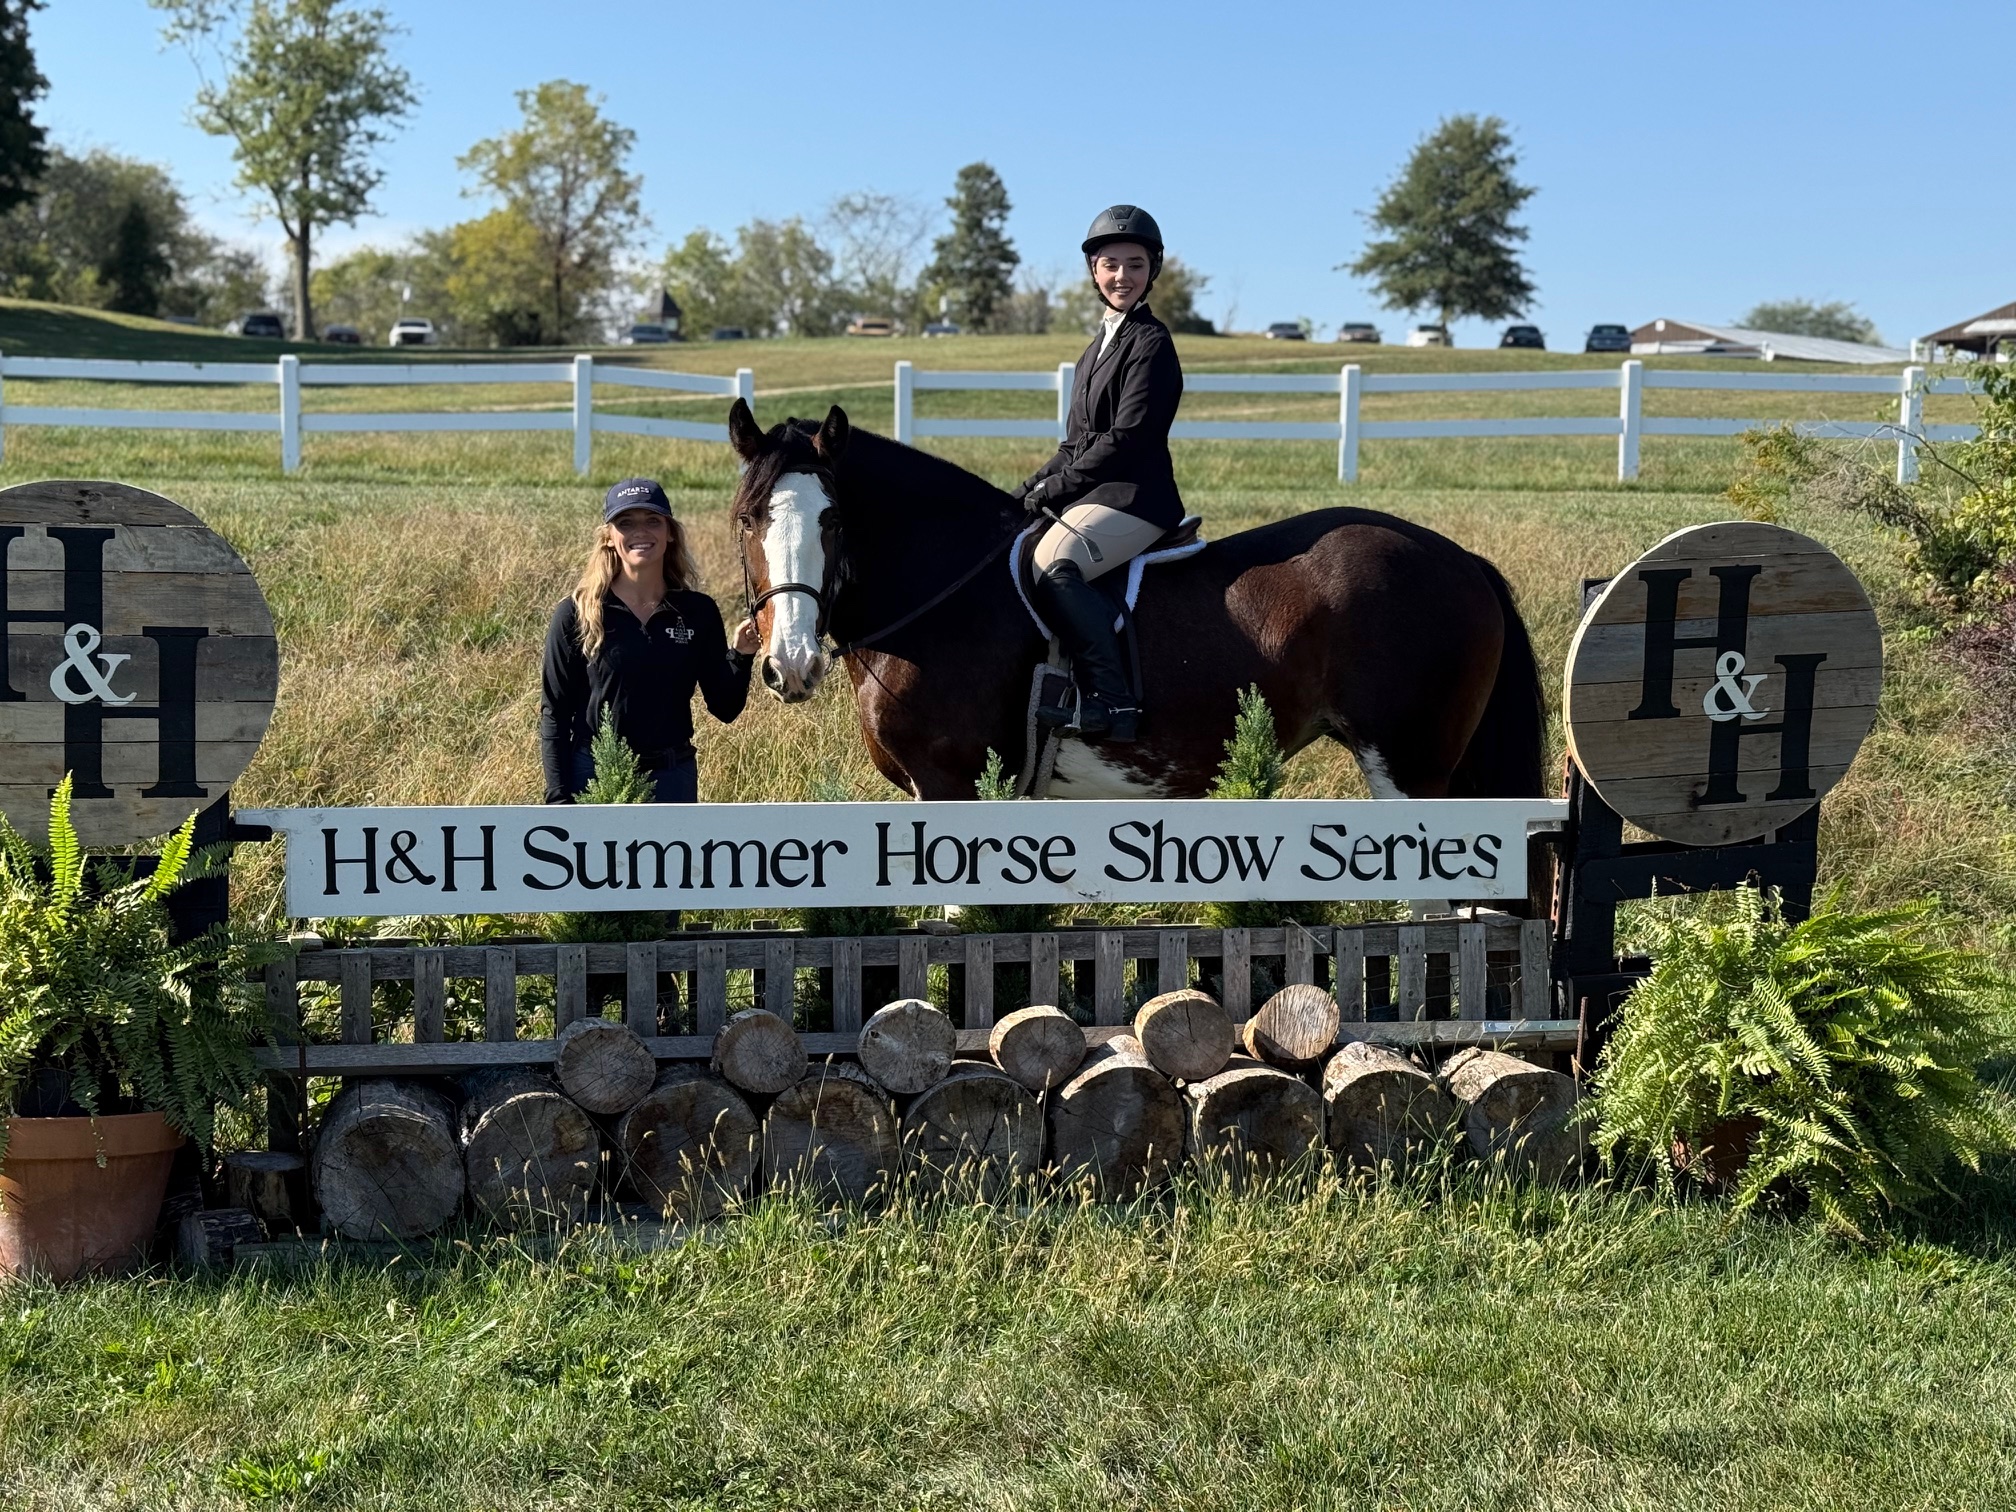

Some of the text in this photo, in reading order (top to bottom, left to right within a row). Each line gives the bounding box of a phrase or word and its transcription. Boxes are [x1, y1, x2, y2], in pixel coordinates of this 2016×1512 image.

[320, 818, 1502, 896] H&H Summer Horse Show Series
